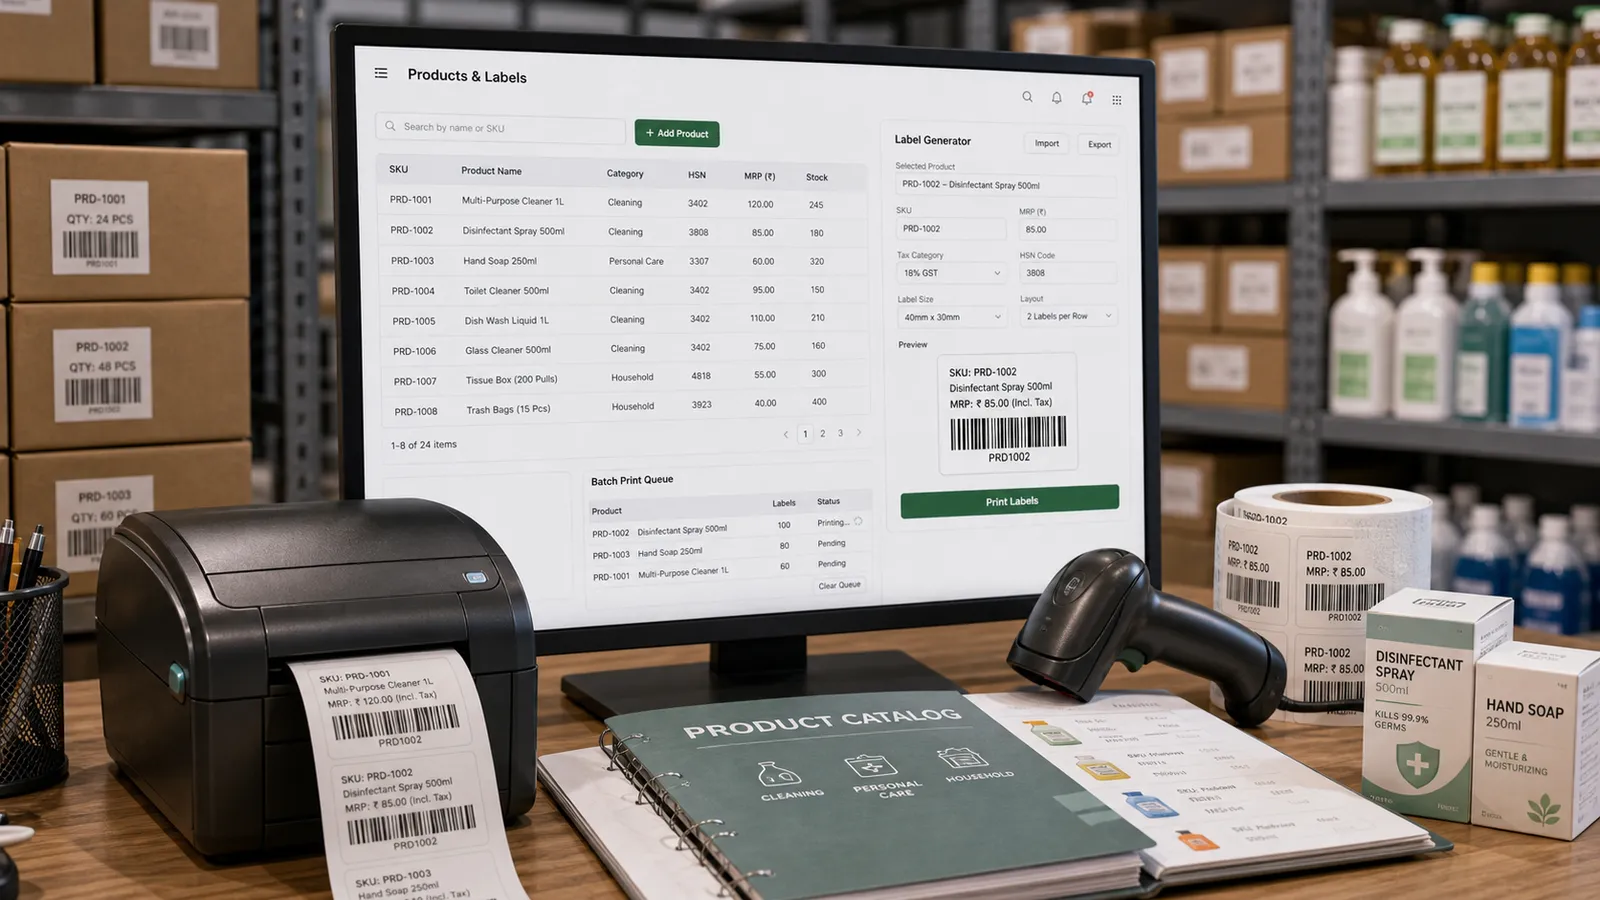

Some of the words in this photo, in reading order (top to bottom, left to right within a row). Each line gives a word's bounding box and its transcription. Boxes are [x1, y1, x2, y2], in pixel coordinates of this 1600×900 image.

[408, 68, 467, 81] Products
[471, 70, 480, 82] &
[484, 71, 526, 83] Labels
[404, 122, 433, 131] Search
[436, 123, 445, 133] by
[486, 124, 504, 133] SKU
[657, 128, 674, 137] Add
[676, 129, 708, 138] Product
[895, 134, 921, 144] Label
[923, 135, 971, 145] Generator
[1035, 139, 1059, 148] Import
[1088, 140, 1111, 149] Export
[389, 164, 408, 173] SKU
[461, 165, 495, 175] Product
[497, 167, 522, 175] Name
[606, 168, 644, 179] Category
[688, 170, 706, 179] HSN
[744, 171, 762, 179] MRP
[806, 172, 828, 181] Stock
[74, 193, 125, 204] PRD-1001
[390, 195, 431, 204] PRD-1001
[462, 196, 520, 206] Multi-Purpose
[521, 196, 552, 205] Cleaner
[555, 197, 564, 205] 1L
[607, 197, 642, 208] Cleaning
[688, 198, 708, 207] 3402
[748, 199, 773, 208] 120.00
[809, 200, 823, 208] 245
[66, 213, 92, 225] QTY:
[96, 214, 108, 224] 24
[111, 213, 133, 224] PCS
[391, 256, 434, 265] PRD-1003
[463, 256, 485, 265] Hand
[488, 256, 509, 266] Soap
[511, 256, 537, 265] 250ml
[609, 256, 643, 265] Personal
[645, 256, 664, 265] Care
[689, 257, 709, 265] 3307
[752, 257, 774, 265] 60.00
[809, 257, 824, 265] 320
[911, 251, 944, 260] Category
[904, 268, 920, 277] 18%
[921, 268, 938, 276] GST
[904, 313, 928, 321] 40mm
[936, 313, 960, 321] 30mm
[76, 340, 129, 352] PRD-1002
[69, 362, 94, 373] QTY:
[97, 361, 111, 371] 48
[114, 360, 136, 371] PCS
[611, 401, 654, 410] Household
[691, 400, 712, 408] 3923
[754, 398, 776, 407] 40.00
[811, 397, 827, 405] 400
[950, 399, 972, 408] MRP:
[984, 398, 1009, 408] 85.00
[1011, 397, 1032, 408] (Incl.
[1034, 397, 1052, 407] Tax)
[394, 406, 437, 416] PRD-1008
[466, 406, 490, 414] Trash
[492, 405, 514, 415] Bags
[516, 404, 530, 414] (15
[532, 404, 550, 413] Pcs)
[408, 440, 417, 449] of
[420, 440, 430, 449] 24
[433, 440, 457, 448] items
[591, 476, 617, 486] Batch
[620, 475, 641, 484] Print
[643, 475, 673, 484] Queue
[78, 489, 131, 503] PRD-1003
[986, 497, 1008, 506] Print
[1009, 495, 1038, 505] Labels
[817, 539, 845, 547] Pending
[1306, 550, 1351, 561] PRD-1002
[1248, 561, 1269, 573] 85.00
[1306, 566, 1329, 576] MRP:
[1340, 566, 1365, 577] 85.00
[818, 582, 837, 590] Clear
[1304, 646, 1350, 658] PRD-1002
[1376, 650, 1463, 673] DISINFECTANT
[1304, 663, 1328, 673] MRP:
[1339, 663, 1364, 674] 85.00
[1376, 665, 1415, 681] SPRAY
[319, 674, 343, 683] SKU:
[344, 670, 390, 680] PRD-1001
[323, 683, 385, 694] Multi-Purpose
[387, 680, 420, 689] Cleaner
[422, 677, 433, 685] 1L
[1375, 681, 1408, 695] 500ml
[327, 699, 352, 708] MRP:
[362, 694, 393, 705] 120.00
[395, 692, 417, 703] (Incl.
[418, 690, 437, 699] Tax)
[1486, 697, 1524, 714] HAND
[1528, 703, 1564, 719] SOAP
[1375, 710, 1399, 720] KILLS
[1401, 712, 1429, 724] 99.9%
[683, 715, 835, 741] PRODUCT
[841, 708, 962, 724] CATALOG
[1374, 720, 1406, 732] GERMS
[1486, 716, 1521, 730] 250ml
[378, 734, 422, 747] PRD1002
[1484, 748, 1518, 760] GENTLE
[1521, 753, 1527, 761] &
[1484, 759, 1548, 776] MOISTURIZING
[340, 774, 364, 784] SKU:
[366, 767, 413, 781] PRD-1002
[945, 771, 1014, 782] HOUSEHOLD
[342, 784, 396, 798] Disinfectant
[398, 782, 423, 792] Spray
[425, 776, 452, 788] 500ml
[852, 780, 922, 794] PERSONAL
[760, 789, 824, 801] CLEANING
[879, 789, 914, 798] CARE
[345, 802, 370, 813] MRP:
[381, 797, 407, 808] 85.00
[409, 795, 431, 806] (Incl.
[432, 791, 452, 801] Tax)
[393, 836, 437, 850] PRD1002
[355, 877, 380, 888] SKU:
[383, 869, 432, 884] PRD-1003
[385, 887, 408, 897] Soap
[410, 880, 439, 893] 250ml
[449, 888, 470, 898] Tax)
